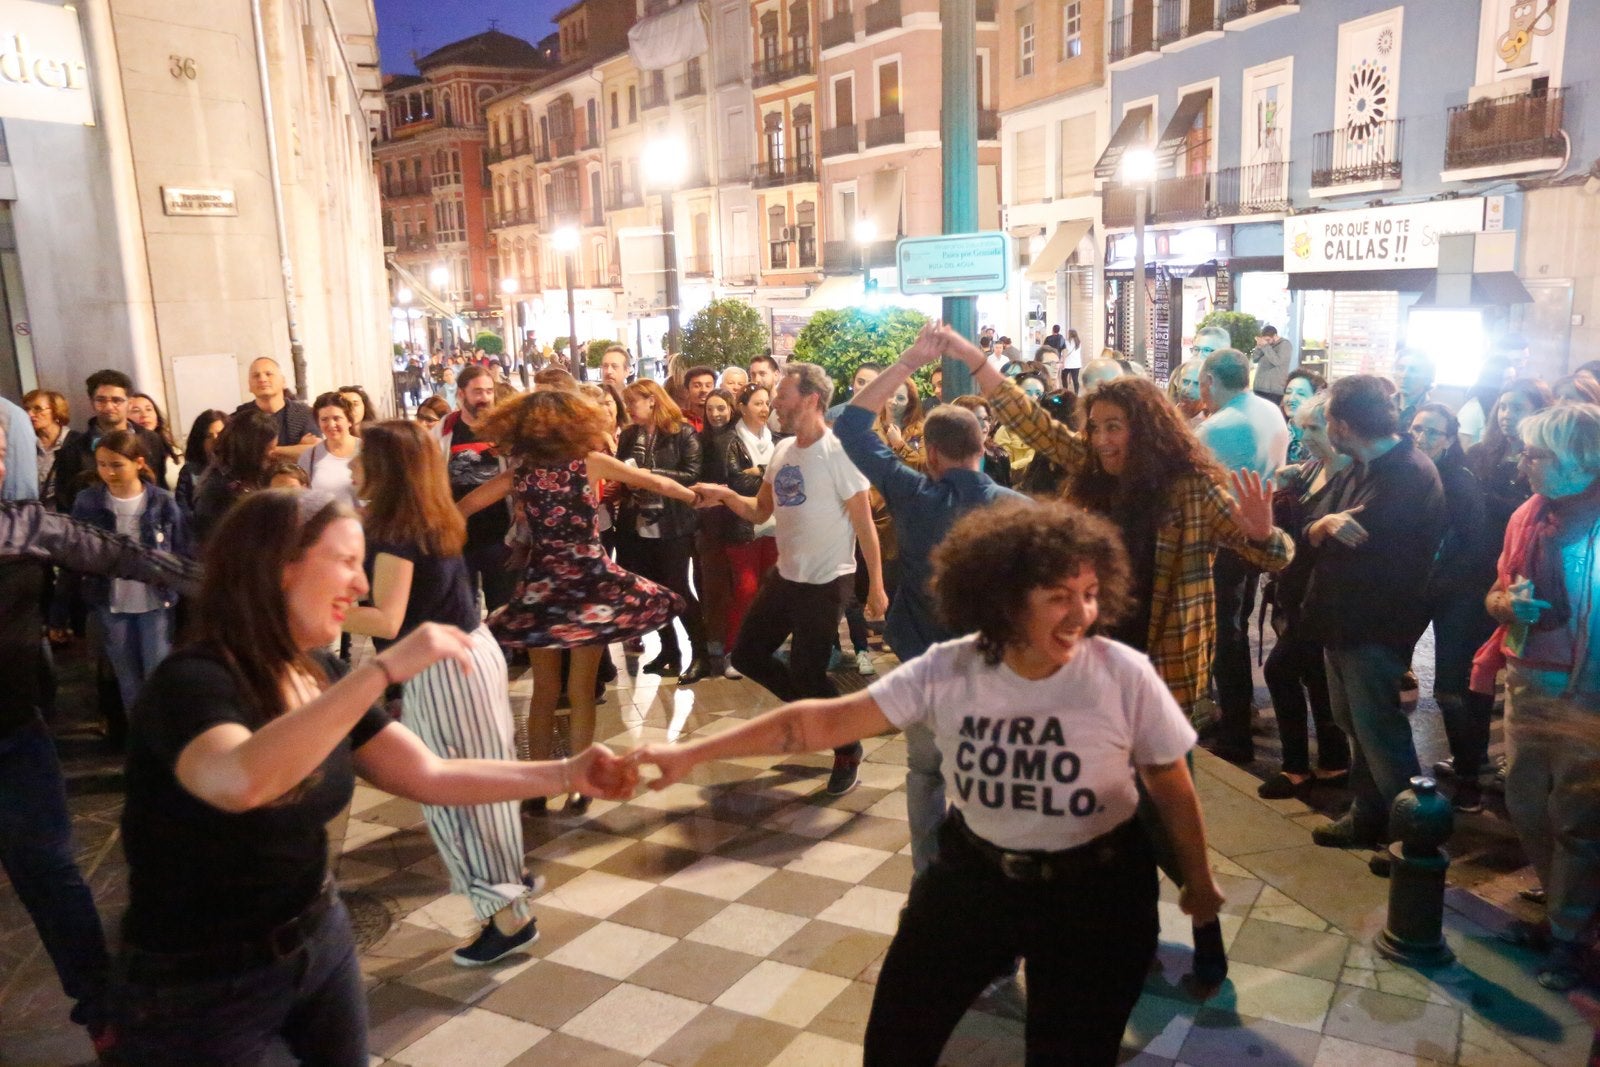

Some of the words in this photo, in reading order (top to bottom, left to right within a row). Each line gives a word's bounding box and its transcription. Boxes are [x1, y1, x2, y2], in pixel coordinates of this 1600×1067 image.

[169, 55, 196, 80] 36
[1325, 223, 1344, 237] POR
[1375, 219, 1392, 235] NO
[1396, 219, 1410, 233] TE
[959, 716, 1066, 746] MIRA
[956, 741, 1081, 783] COMO
